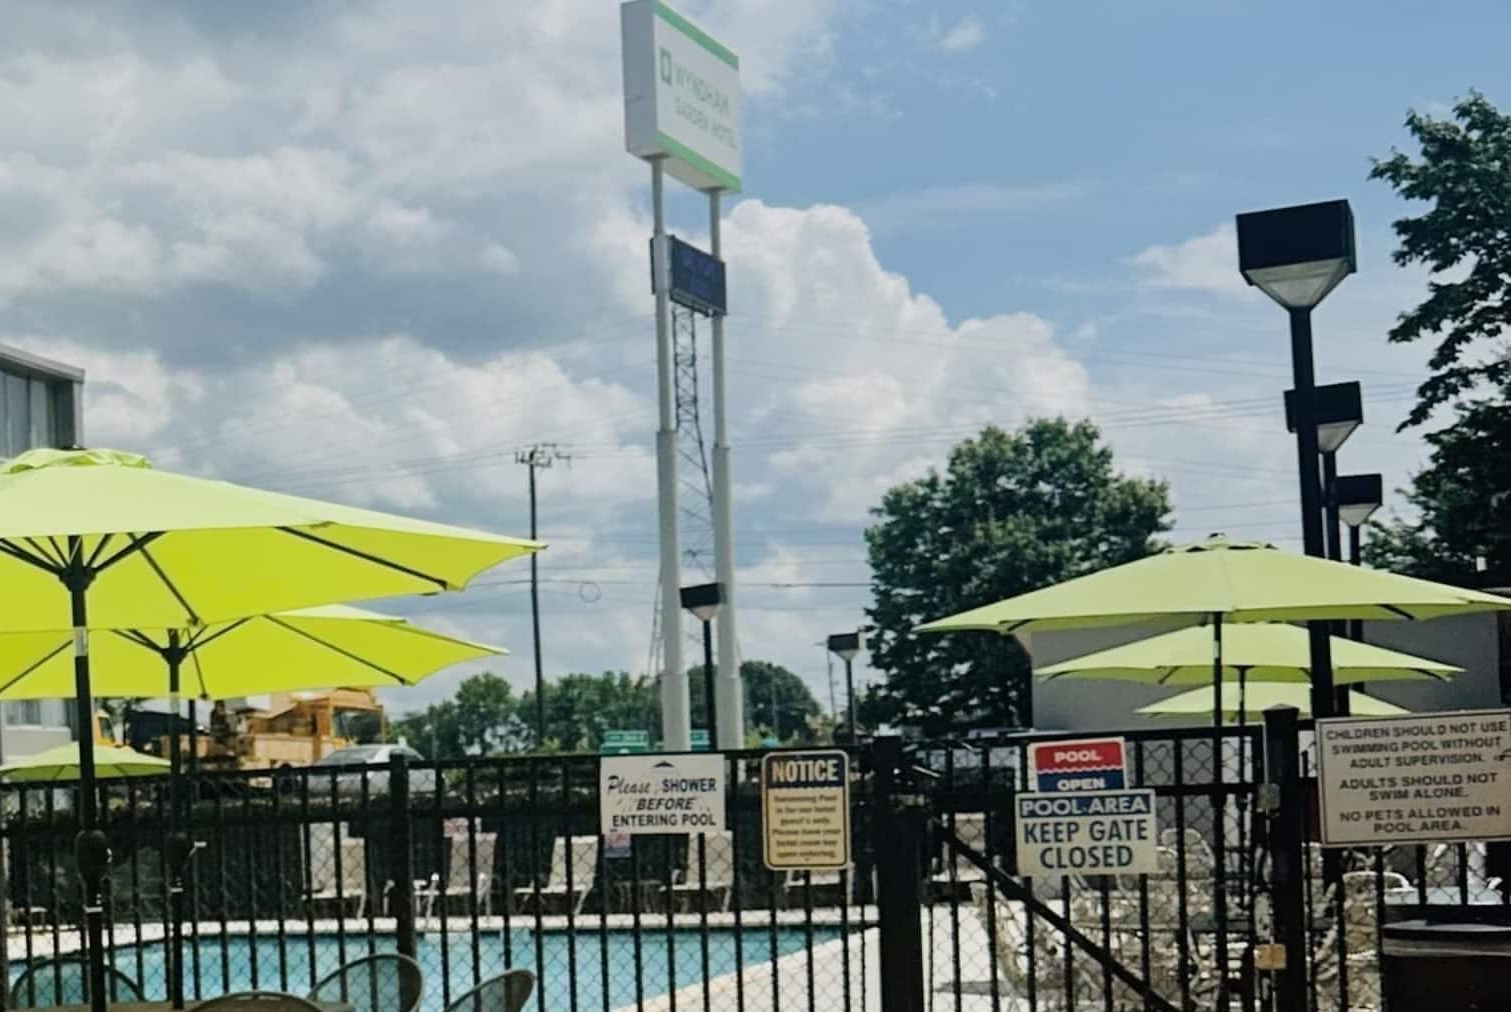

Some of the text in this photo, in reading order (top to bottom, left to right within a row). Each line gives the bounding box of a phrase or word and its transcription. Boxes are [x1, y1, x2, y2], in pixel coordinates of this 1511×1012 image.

[1326, 721, 1507, 740] CHILDREN SHOULD NOT USE
[1332, 736, 1501, 755] SWIMMING POOL WITHOUT
[1054, 750, 1103, 763] POOL
[1350, 757, 1390, 769] ADULT
[772, 760, 839, 783] NOTICE
[607, 775, 716, 795] Please SHOWER
[1057, 778, 1106, 791] OPEN
[1340, 772, 1498, 790] ADULTS SHOULD NOT
[636, 797, 697, 811] BEFORE
[1370, 789, 1410, 802] SWIM
[1021, 795, 1147, 817] POOL AREA
[1340, 805, 1501, 822] NO PETS ALLOWED IN
[612, 813, 716, 828] ENTERING POOL
[1374, 821, 1416, 833] POOL
[1024, 819, 1148, 843] KEEP GATE
[1040, 846, 1133, 869] CLOSED
